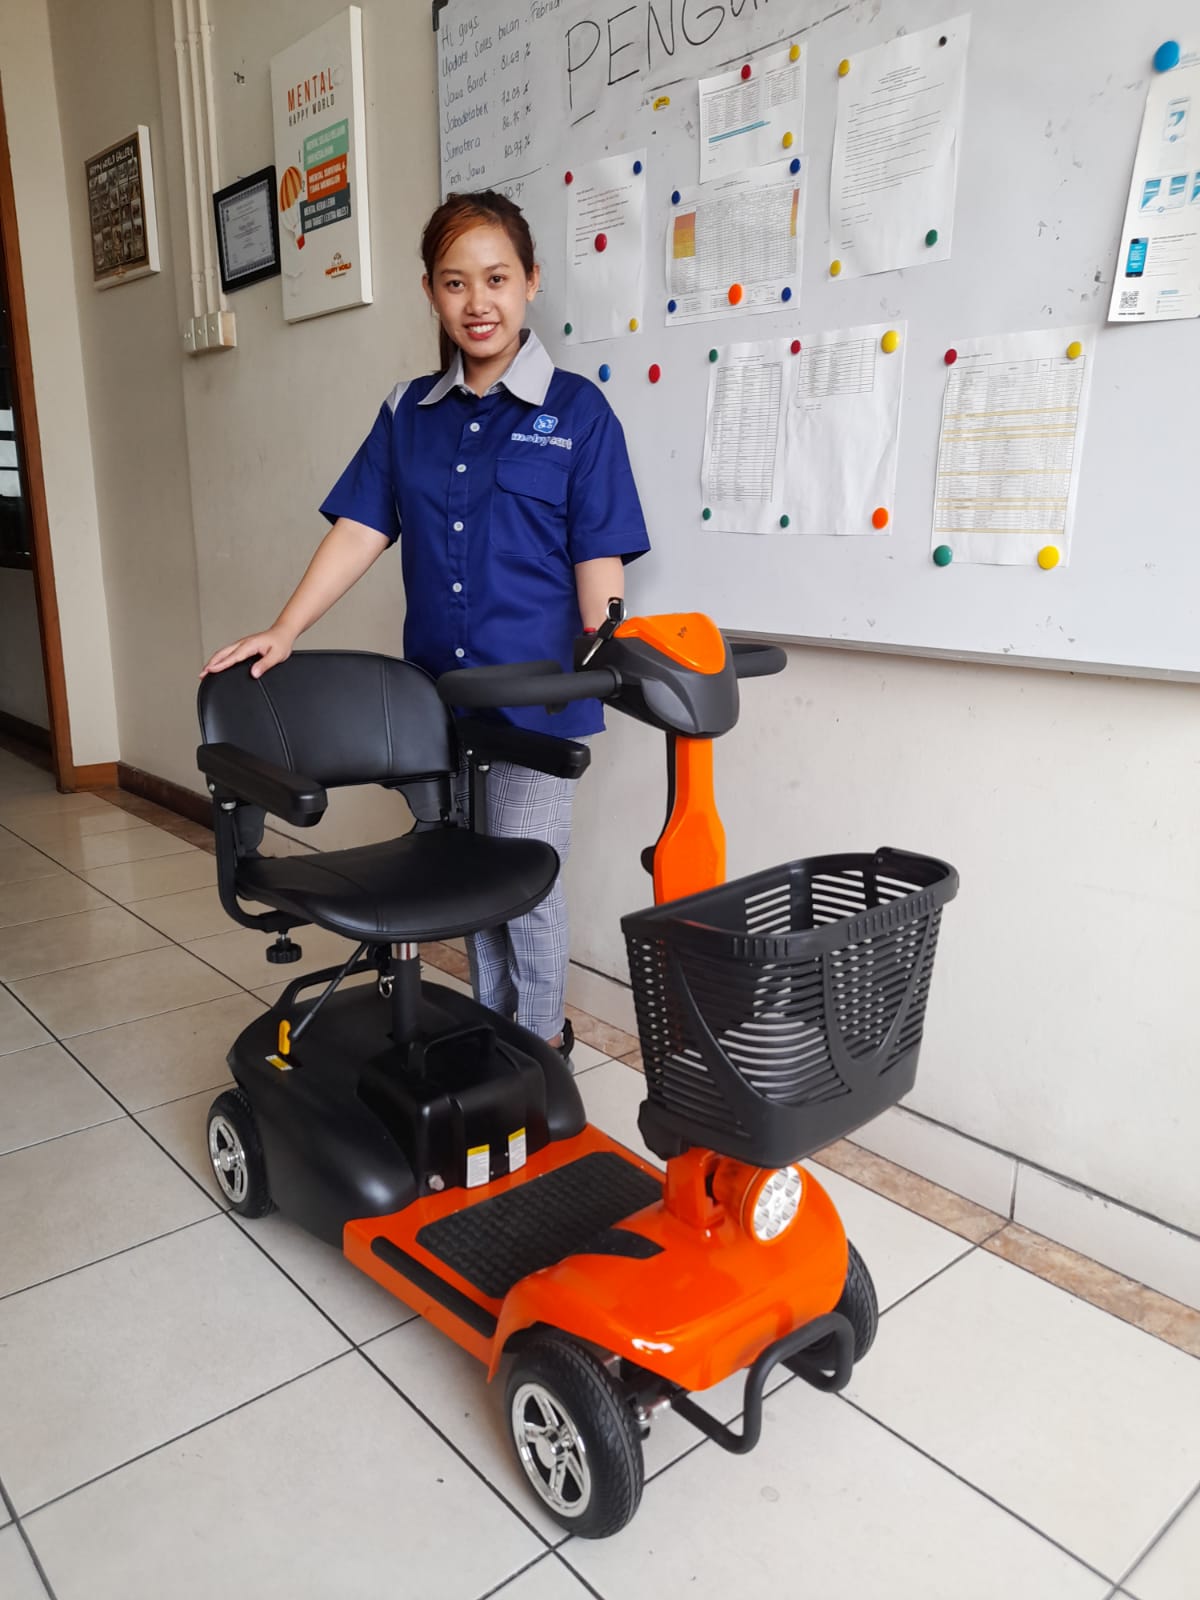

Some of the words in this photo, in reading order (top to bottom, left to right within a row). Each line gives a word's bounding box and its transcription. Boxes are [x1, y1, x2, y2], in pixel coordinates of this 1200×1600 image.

[459, 15, 480, 46] guys
[442, 50, 468, 78] Update
[287, 67, 334, 113] MENTAL
[288, 107, 309, 128] HAPPY
[312, 93, 335, 115] WORLD
